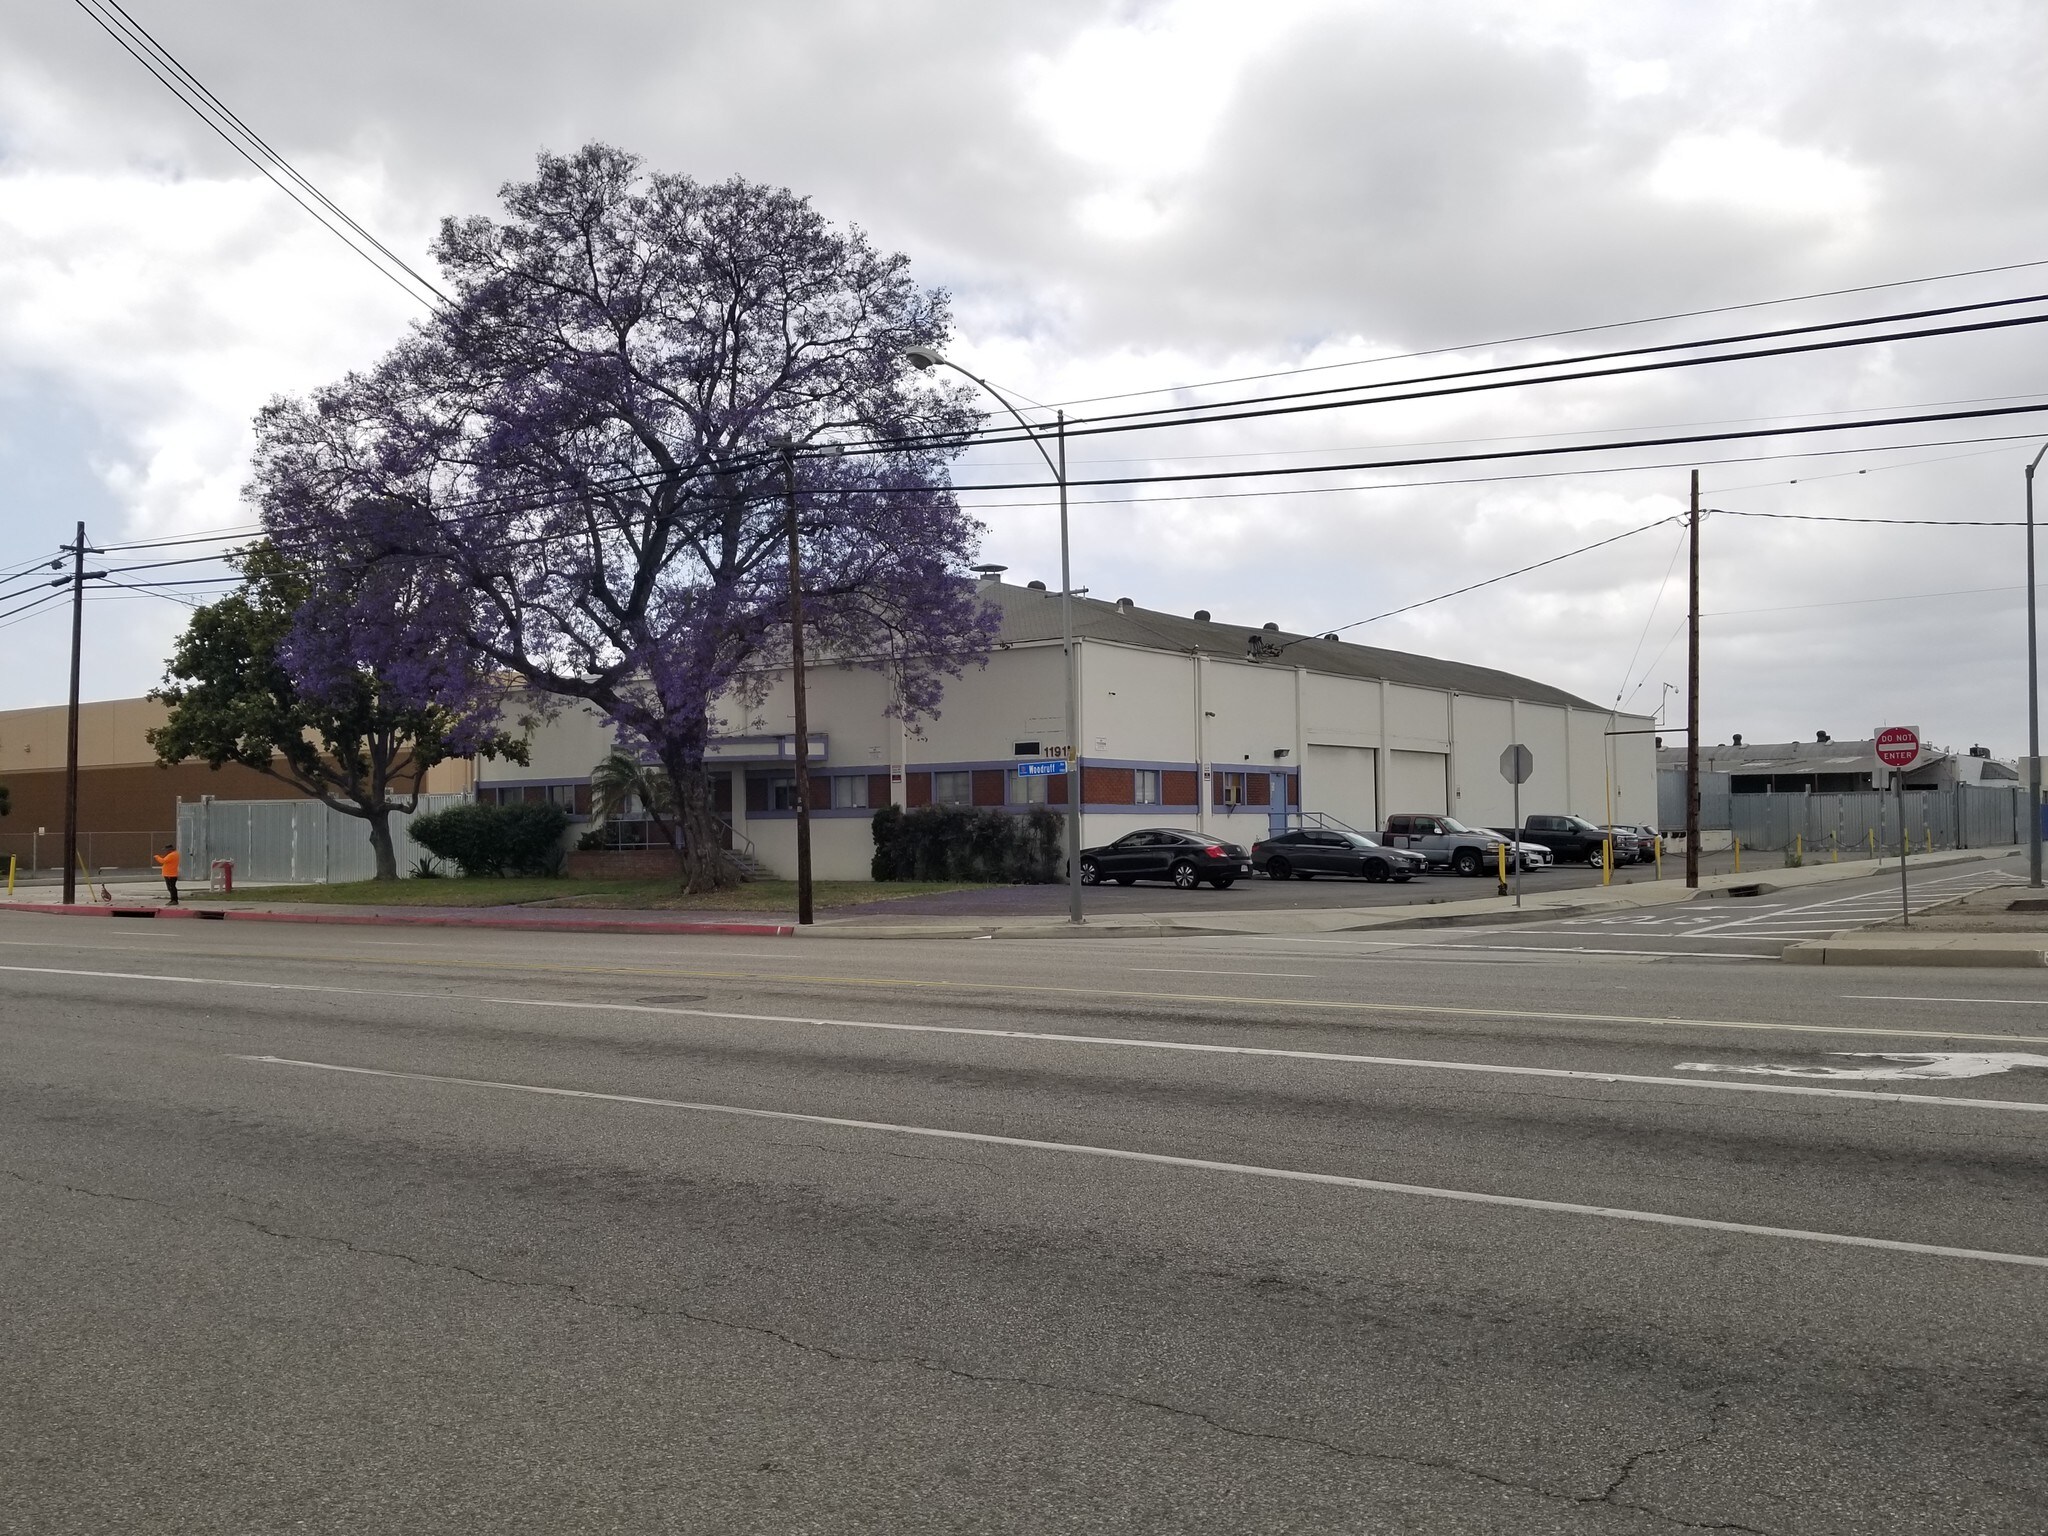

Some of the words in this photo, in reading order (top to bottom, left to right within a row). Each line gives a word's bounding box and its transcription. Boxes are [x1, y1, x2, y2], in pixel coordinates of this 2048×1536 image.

[1896, 734, 1912, 742] NOT
[1044, 745, 1071, 758] 1191
[1884, 752, 1912, 760] ENTER
[1029, 763, 1055, 774] Woodruff
[1561, 915, 1731, 925] STOP
